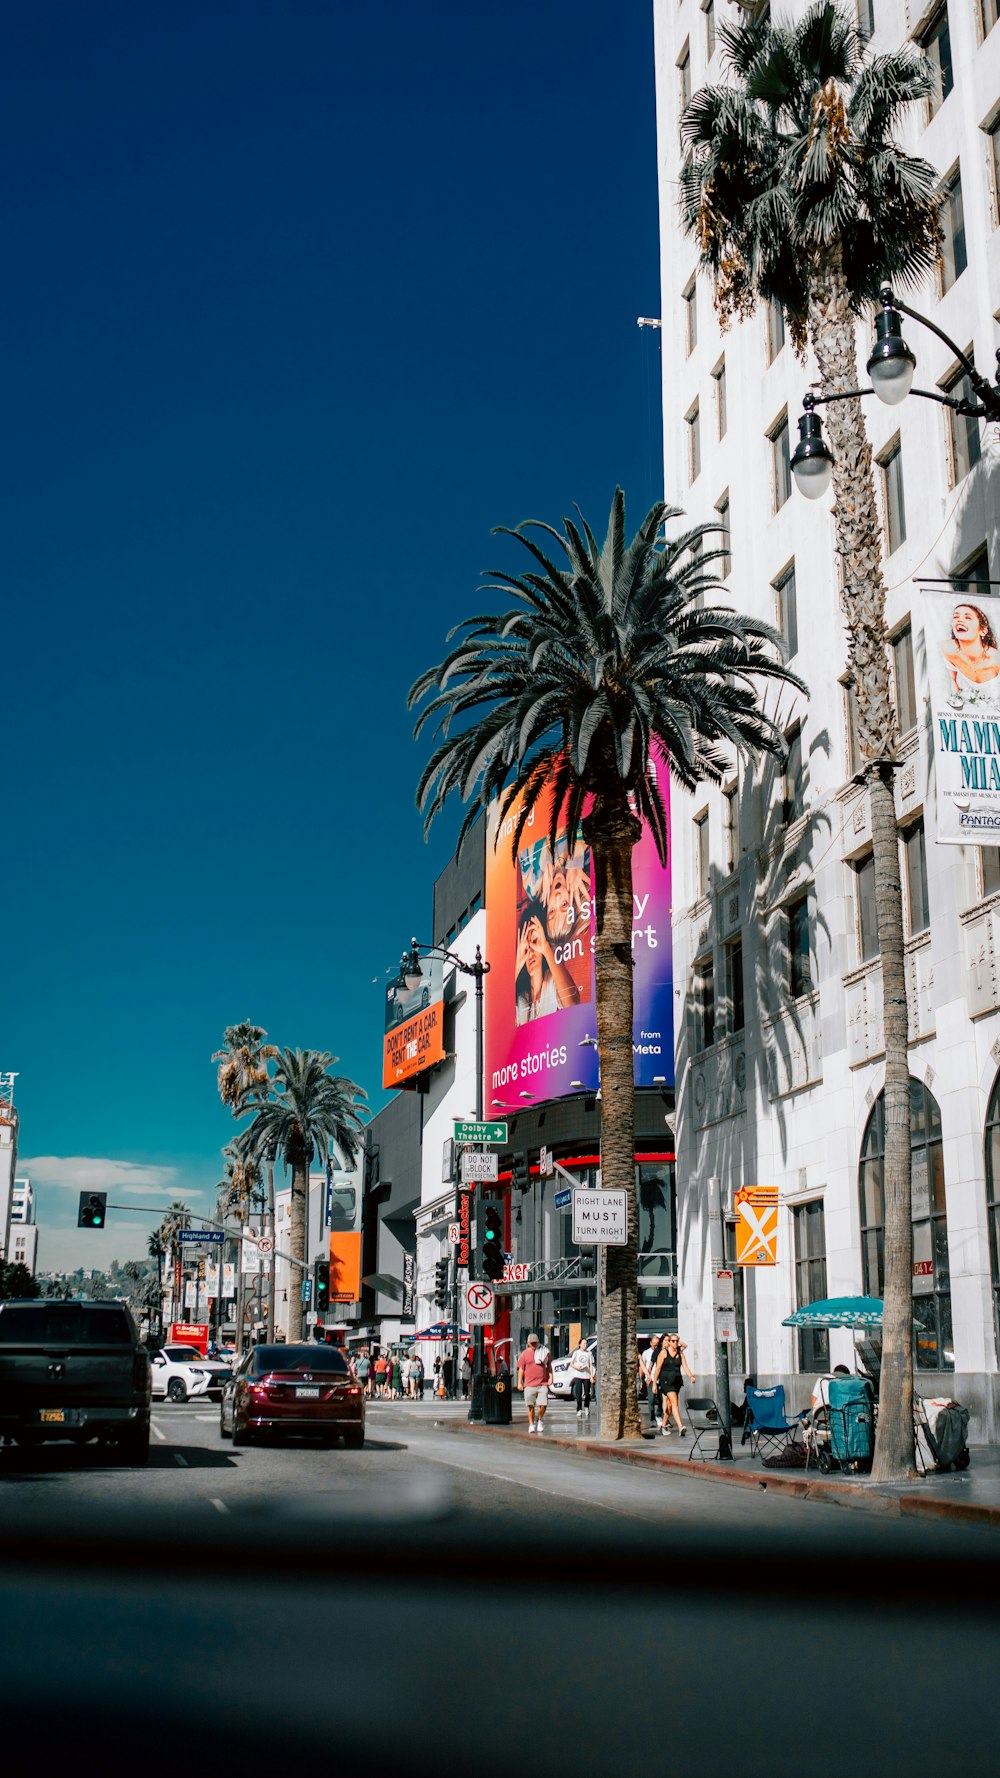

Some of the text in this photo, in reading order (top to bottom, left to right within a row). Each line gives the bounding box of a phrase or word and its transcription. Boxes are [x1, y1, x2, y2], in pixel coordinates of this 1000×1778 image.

[960, 755, 1000, 790] MIA
[566, 893, 650, 925] a sty
[554, 938, 584, 965] can
[387, 1011, 438, 1054] DON'T RENT A CAR.
[641, 1030, 661, 1039] from
[392, 1046, 406, 1068] RENT
[406, 1039, 418, 1060] THE
[417, 1033, 431, 1054] CAR.
[633, 1044, 661, 1055] Meta
[492, 1043, 567, 1090] more stories
[462, 1124, 487, 1134] Dolby
[457, 1132, 492, 1141] Theatre
[468, 1155, 492, 1164] DO NOT
[470, 1164, 491, 1173] BLOCK
[576, 1197, 600, 1206] RIGHT
[602, 1198, 624, 1207] LANE
[582, 1211, 618, 1222] MUST
[458, 1193, 470, 1265] Foot Locker
[576, 1226, 624, 1236] TURN RIGHT
[182, 1232, 210, 1241] Highland
[468, 1312, 478, 1320] ON
